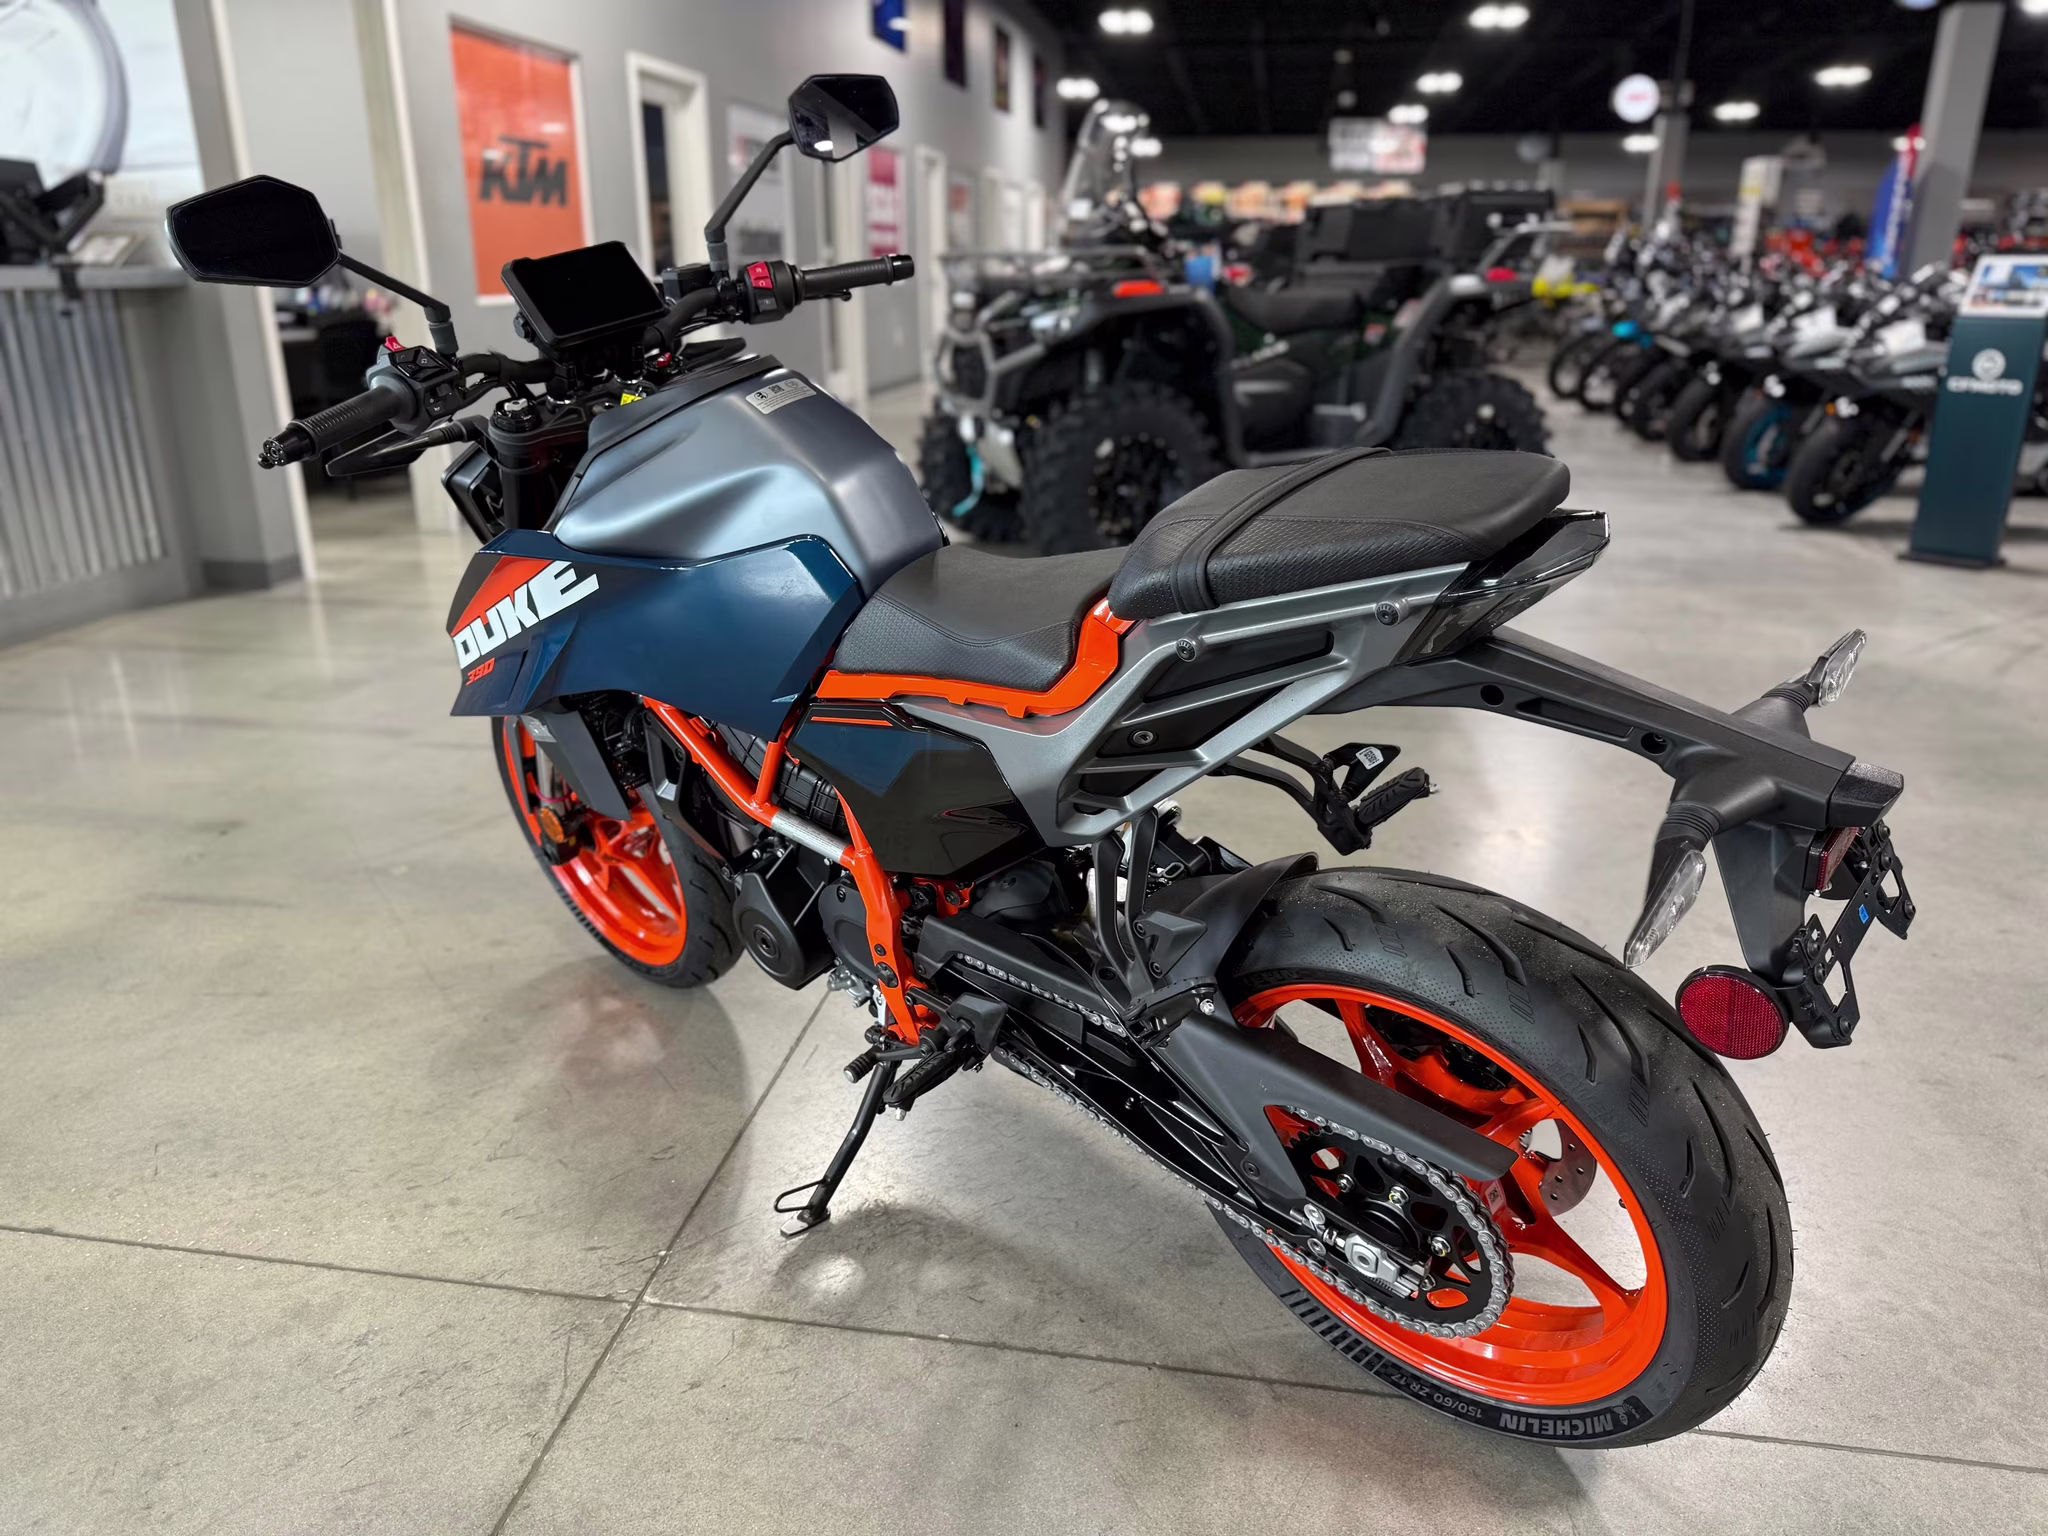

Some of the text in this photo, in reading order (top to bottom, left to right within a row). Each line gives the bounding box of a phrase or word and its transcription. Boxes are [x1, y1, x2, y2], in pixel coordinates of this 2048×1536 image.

[480, 136, 567, 207] KTM
[452, 559, 600, 670] DUKE
[465, 656, 497, 687] 390
[1390, 1372, 1408, 1386] 17
[1433, 1392, 1483, 1419] 150/60
[1499, 1412, 1614, 1437] MICHELIN
